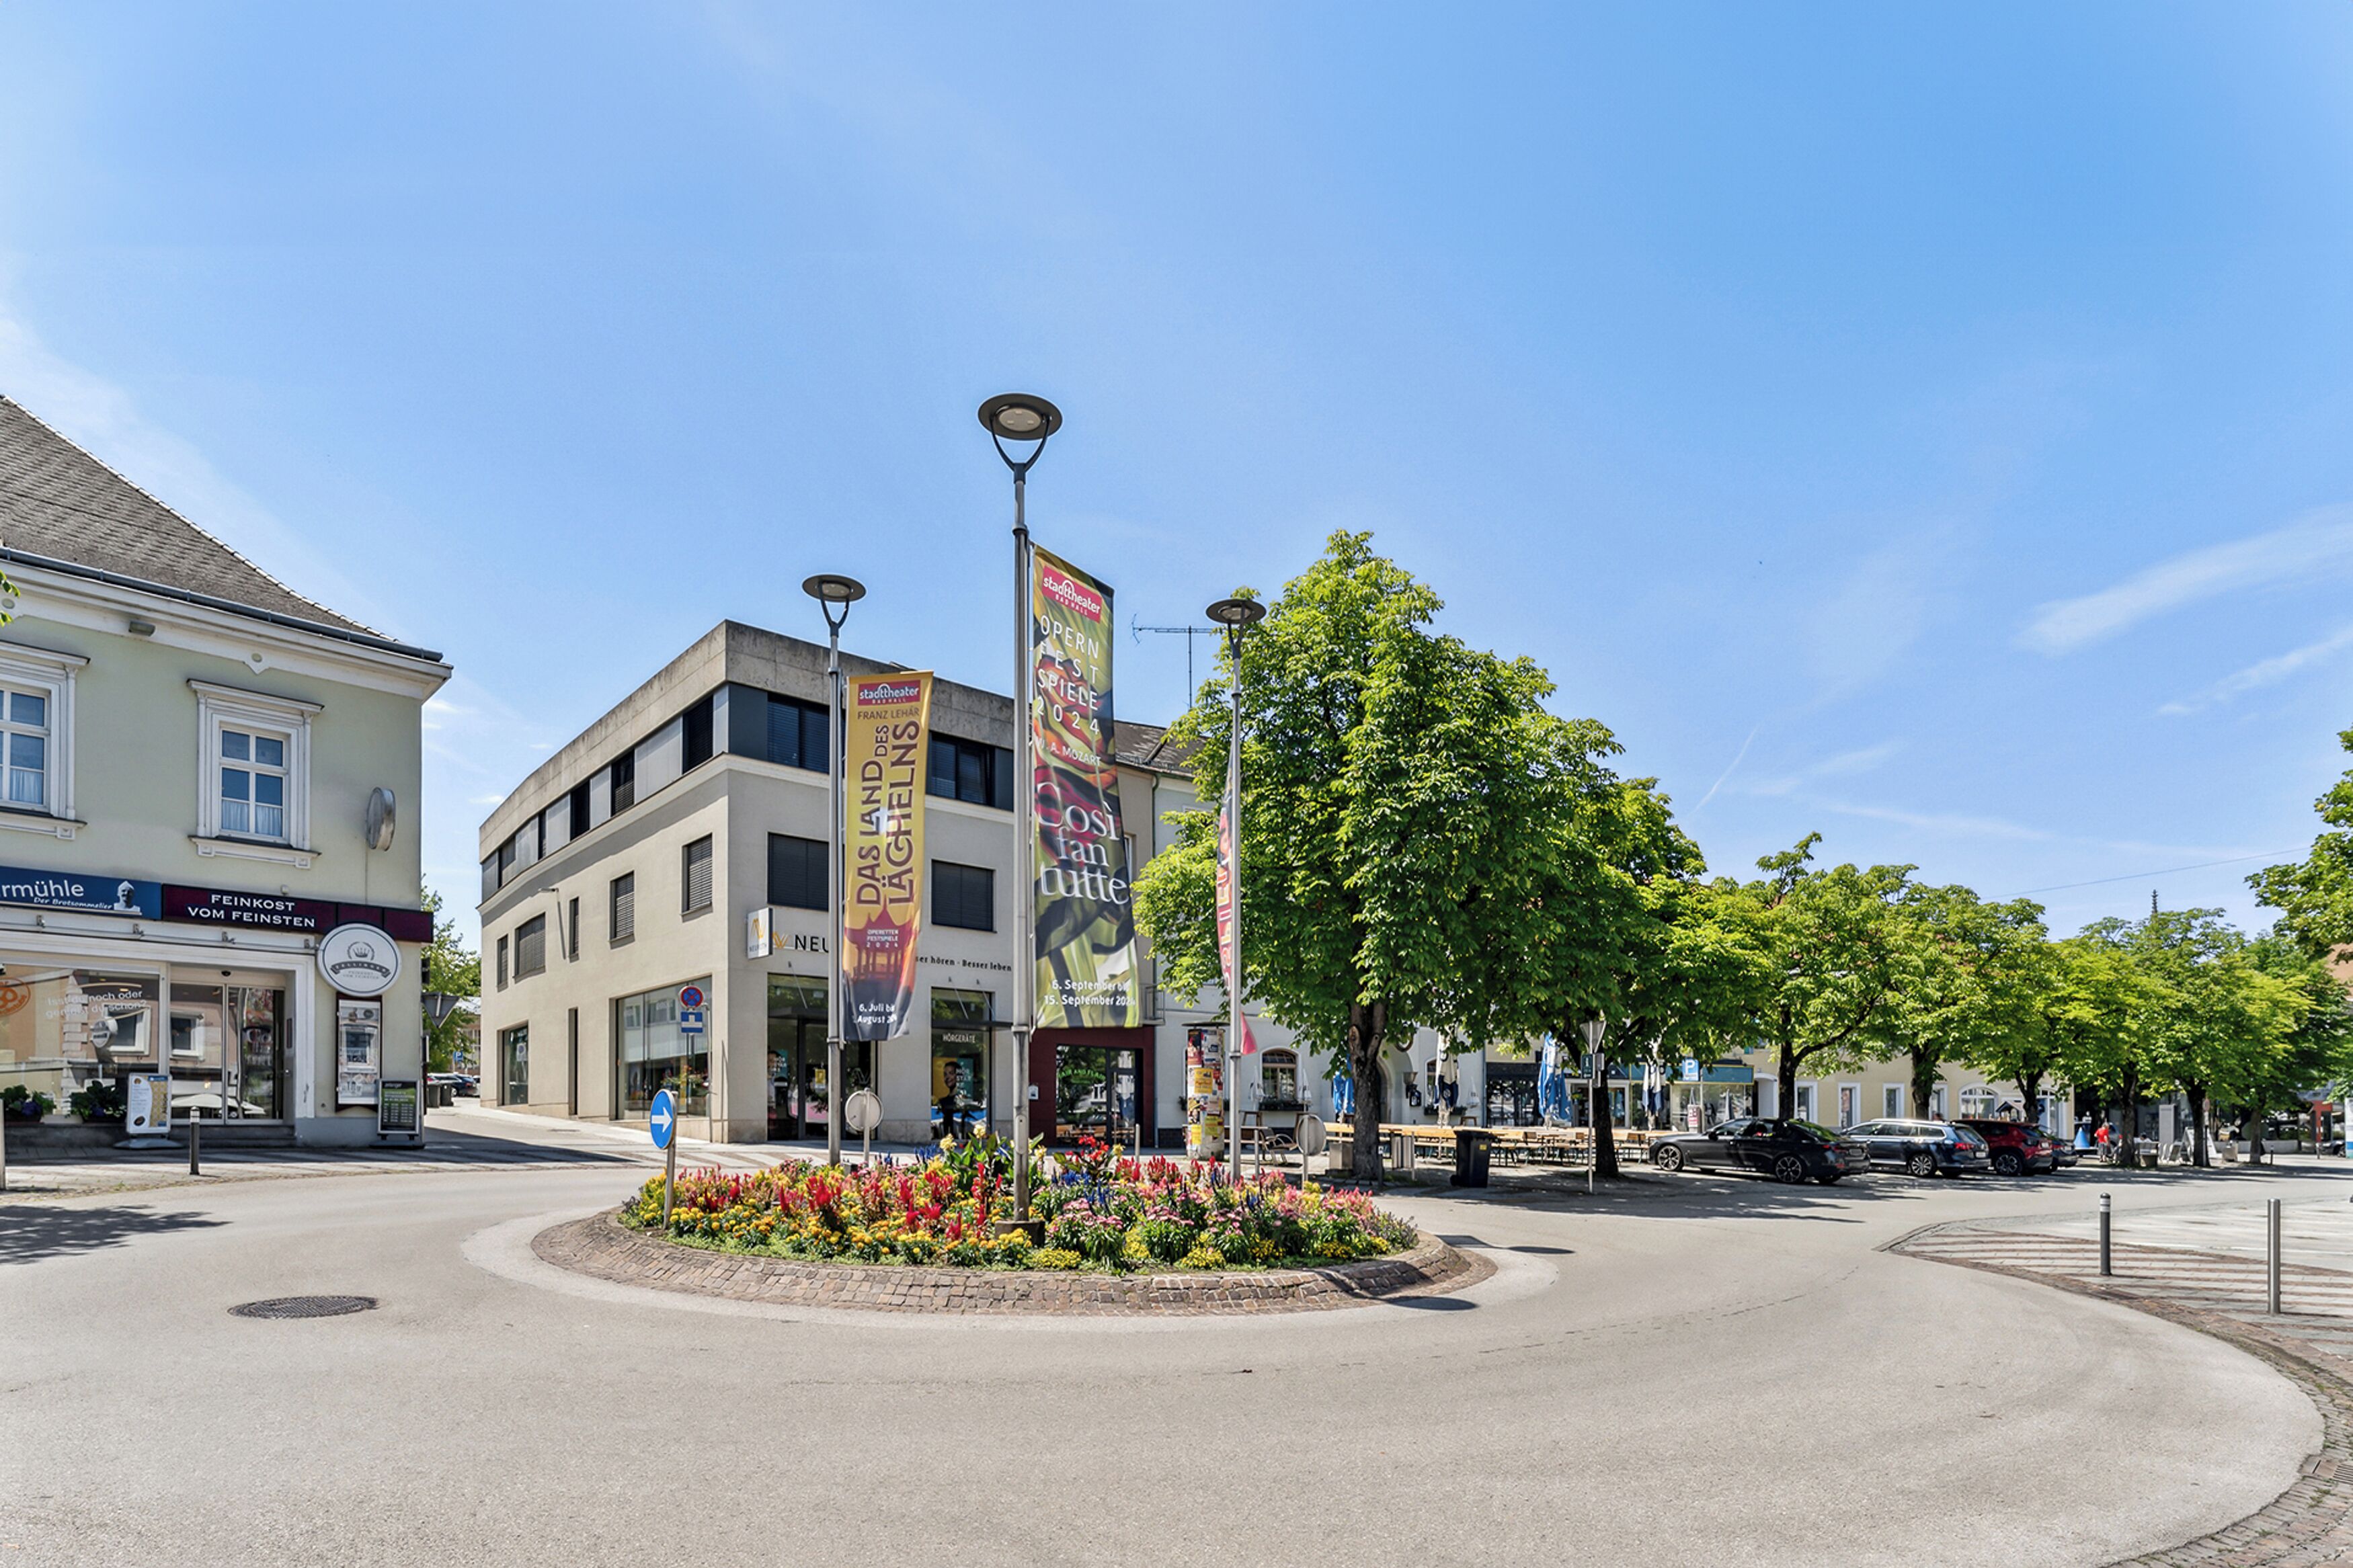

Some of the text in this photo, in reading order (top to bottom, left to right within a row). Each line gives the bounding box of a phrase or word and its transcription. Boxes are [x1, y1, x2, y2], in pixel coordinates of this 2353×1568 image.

[1043, 577, 1101, 614] stadttheater
[1041, 614, 1099, 659] OPERN
[859, 683, 919, 700] stadttheater
[1037, 668, 1099, 710] SPIELE
[857, 705, 920, 720] FRANZ LEHÁR
[1062, 745, 1101, 767] MOZART
[856, 844, 881, 905] DAS
[875, 725, 889, 757] DES
[1057, 826, 1109, 868] fan
[0, 880, 84, 897] rmühle
[1039, 860, 1130, 905] tutte
[52, 898, 112, 910] Brotsommelier
[211, 895, 294, 911] FEINKOST
[188, 906, 315, 927] VOM FEINSTEN
[930, 955, 955, 966] hören
[962, 959, 988, 969] Besser
[990, 962, 1012, 972] leben
[1052, 979, 1062, 990] 6.
[1064, 979, 1116, 992] September
[89, 991, 115, 1002] noch
[118, 991, 143, 999] oder
[1044, 995, 1058, 1005] 15.
[1062, 994, 1114, 1007] September
[859, 1003, 867, 1012] 6.
[869, 1003, 884, 1012] Juli
[858, 1015, 885, 1025] August
